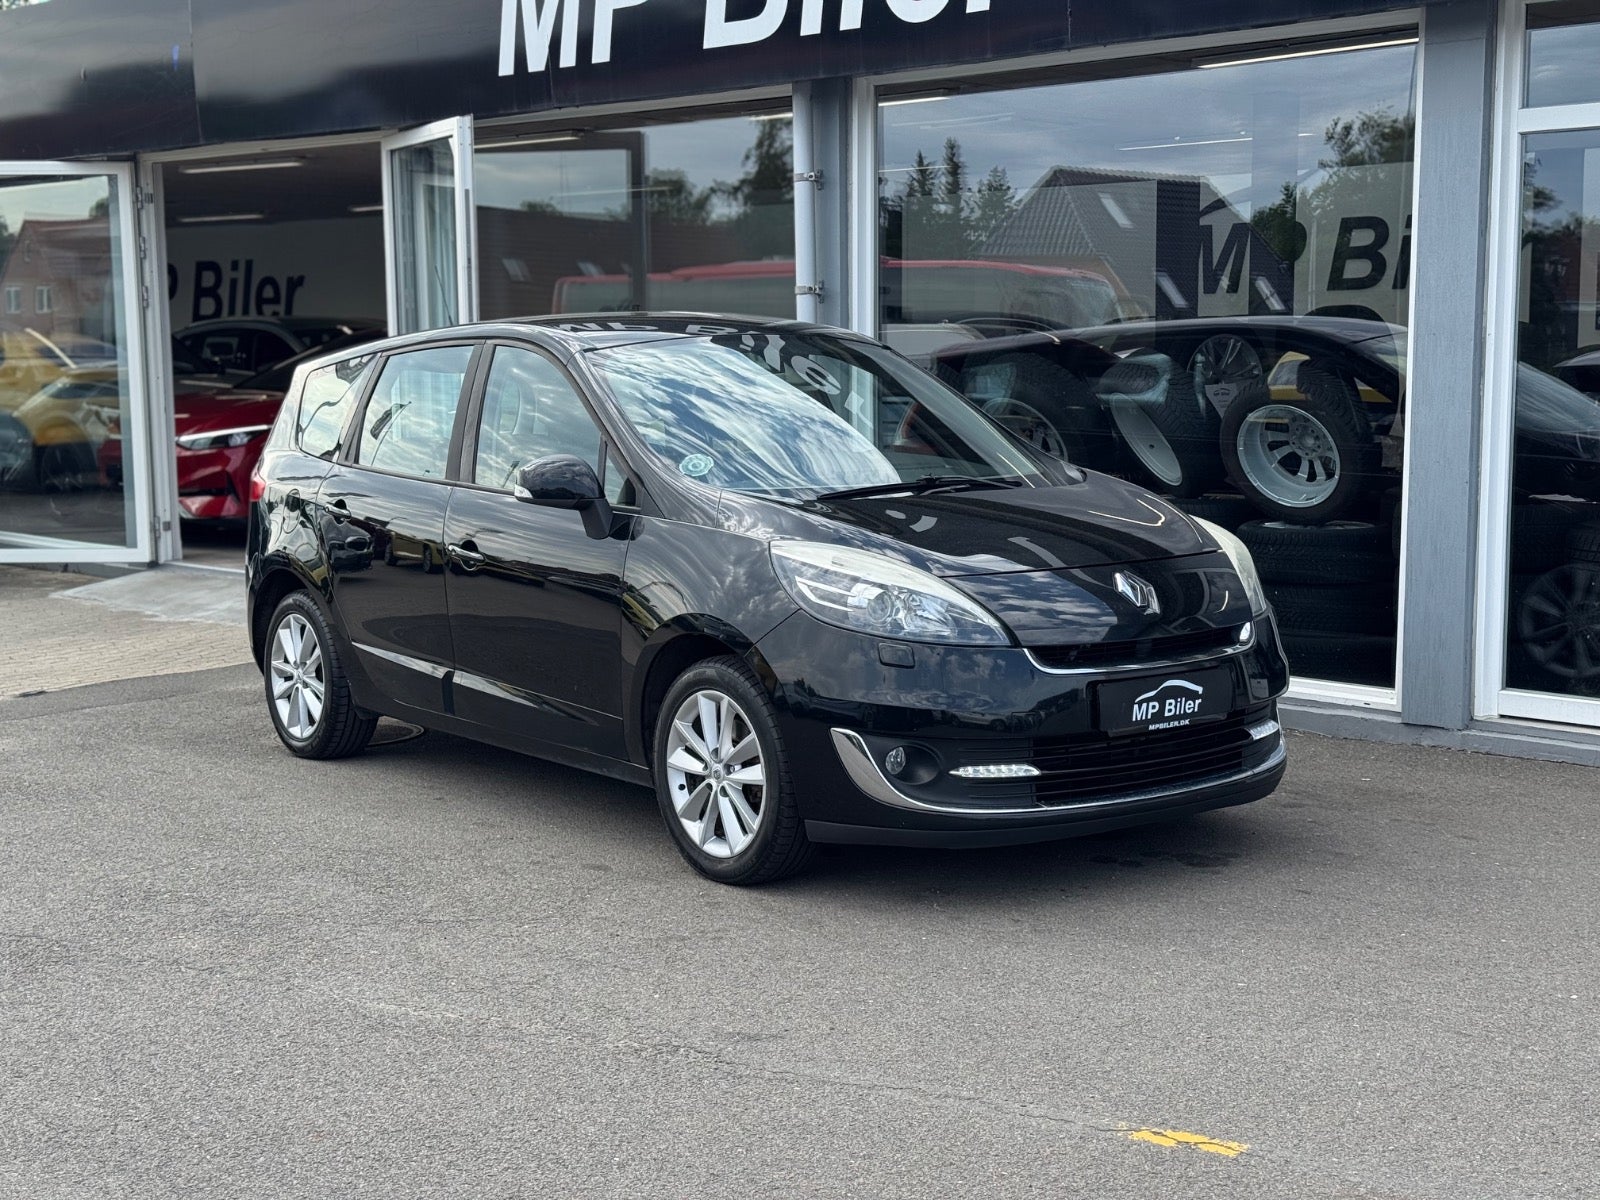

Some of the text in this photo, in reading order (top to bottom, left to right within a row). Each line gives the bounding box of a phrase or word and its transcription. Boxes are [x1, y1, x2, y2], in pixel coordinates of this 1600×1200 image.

[193, 258, 306, 322] Biler
[1132, 697, 1202, 721] MP Biler
